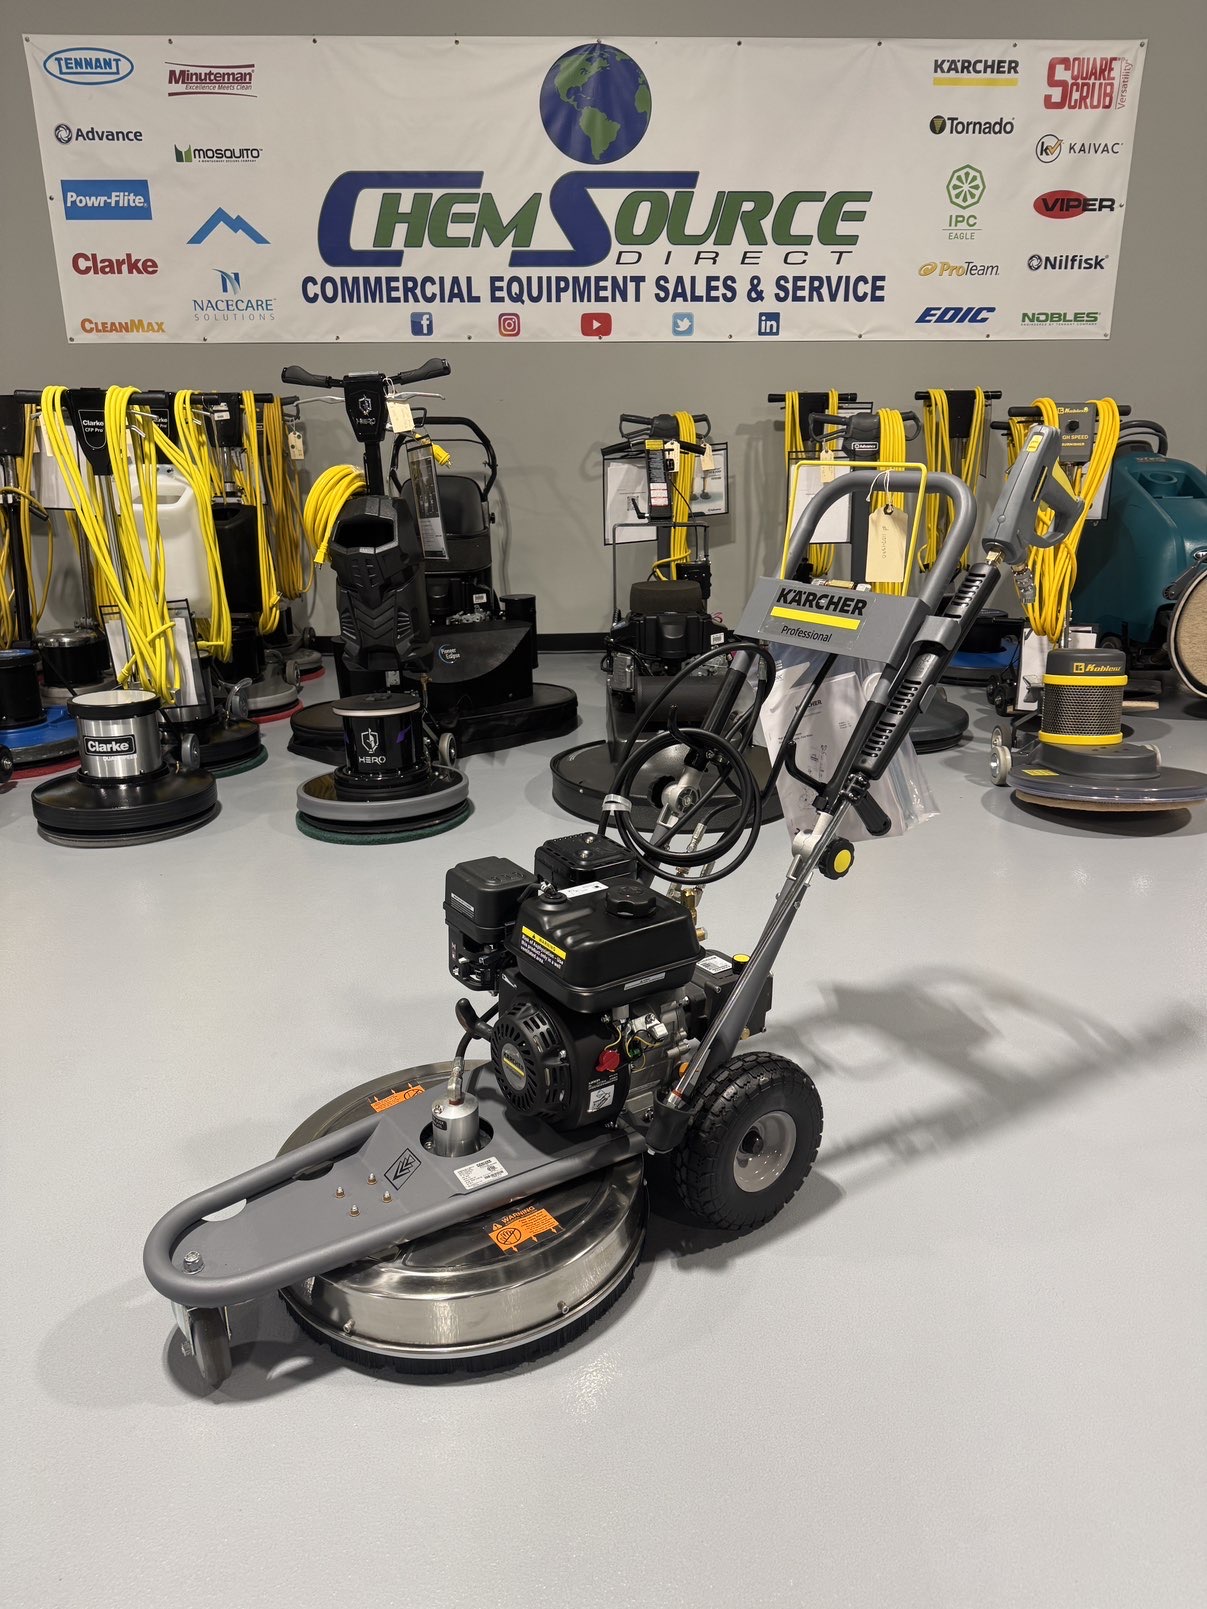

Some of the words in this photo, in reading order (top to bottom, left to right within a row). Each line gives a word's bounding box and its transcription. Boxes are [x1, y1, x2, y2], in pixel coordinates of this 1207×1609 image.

[54, 57, 122, 75] TENNANT
[934, 58, 1020, 74] KÄRCHER
[168, 69, 252, 85] Minuteman
[1117, 60, 1132, 109] Versatility
[947, 117, 1014, 135] Tornado
[75, 127, 143, 142] Advance
[1068, 142, 1121, 154] KAIVAC
[66, 192, 145, 208] Powr-Flite
[1041, 197, 1116, 212] VIPER
[948, 214, 977, 228] IPC
[948, 232, 976, 240] EAGLE
[72, 253, 159, 275] Clarke
[615, 250, 854, 265] DIRECT
[1044, 254, 1105, 270] Nilfisk
[939, 260, 998, 277] ProTeam
[301, 276, 481, 304] COMMERCIAL
[490, 275, 646, 305] EQUIPMENT
[654, 275, 738, 302] SALES
[746, 275, 765, 302] &
[774, 275, 886, 302] SERVICE
[192, 299, 274, 312] NACECARE
[194, 313, 275, 321] SOLUTIONS
[915, 306, 996, 324] EDIC
[1022, 312, 1098, 322] NOBLES
[776, 588, 868, 616] KÄRCHER
[780, 625, 832, 643] Professional
[87, 740, 129, 752] Clarke
[358, 756, 386, 765] HERO
[501, 1206, 536, 1224] WARNING
